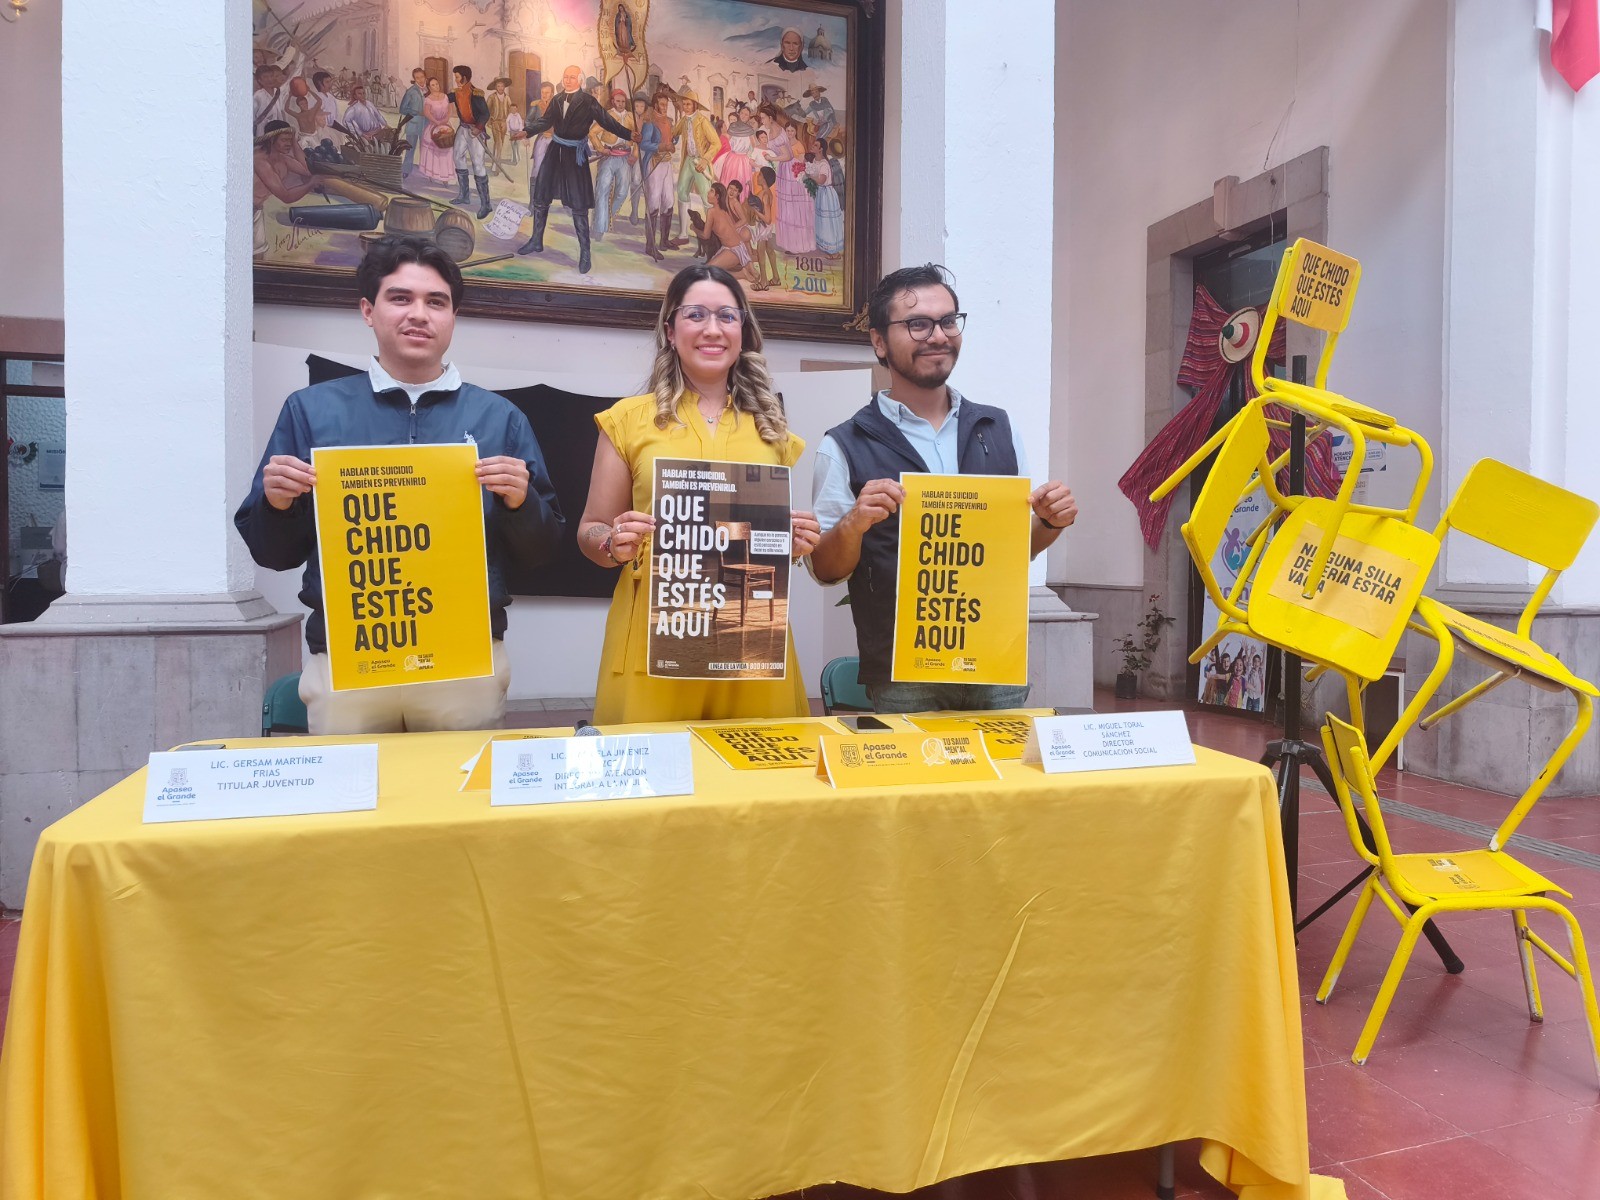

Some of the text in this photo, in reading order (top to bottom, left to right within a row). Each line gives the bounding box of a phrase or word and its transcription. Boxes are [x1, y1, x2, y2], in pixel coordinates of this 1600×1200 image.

[795, 256, 823, 272] 1810
[1302, 252, 1350, 286] QUE CHIDO
[1296, 273, 1315, 296] QUE
[340, 465, 414, 477] HABLAR DE SUICIDIO
[662, 468, 727, 482] HABLAR DE SUICIDIO,
[341, 477, 426, 489] TAMBIÉN ES PREVENIRLO
[662, 479, 737, 493] TAMBIÉN ES PREVENIRLO.
[921, 490, 979, 500] HABLAR DE SUICIDIO
[343, 492, 398, 526] QUE
[660, 494, 705, 524] QUE
[921, 500, 988, 511] TAMBIÉN ES PREVENIRLO
[920, 512, 962, 541] QUE
[346, 523, 431, 555] CHIDO
[659, 523, 729, 552] CHIDO
[918, 541, 985, 567] CHIDO
[658, 552, 703, 582] QUE
[1300, 542, 1402, 591] NIGUNA SILLA
[348, 557, 402, 591] QUE
[1293, 555, 1396, 605] DEERIA ESTAR
[917, 569, 959, 597] QUE
[657, 576, 727, 610] ESTÉS
[351, 581, 434, 620] ESTÉS
[916, 592, 981, 623] ESTÉS
[656, 607, 710, 640] AQUÍ
[354, 611, 418, 653] AQUÍ
[914, 620, 966, 653] AQUÍ
[769, 662, 784, 670] 2000
[1098, 722, 1122, 730] MIGUEL
[718, 731, 764, 739] QUE
[725, 735, 800, 744] CHIDO
[950, 737, 970, 746] SALUD
[731, 742, 779, 750] QUE
[863, 743, 897, 752] Apaseo
[1102, 739, 1135, 748] DIRECTOR
[865, 751, 908, 761] el Grande
[1135, 747, 1158, 755] SOCIAL
[211, 755, 323, 769] LIC. GERSAM MARTÍNEZ
[253, 769, 281, 778] FRIAS
[517, 776, 543, 784] Grande
[162, 785, 193, 794] Apaseo
[217, 778, 315, 791] TITULAR JUVENTUD
[166, 792, 197, 801] Grande
